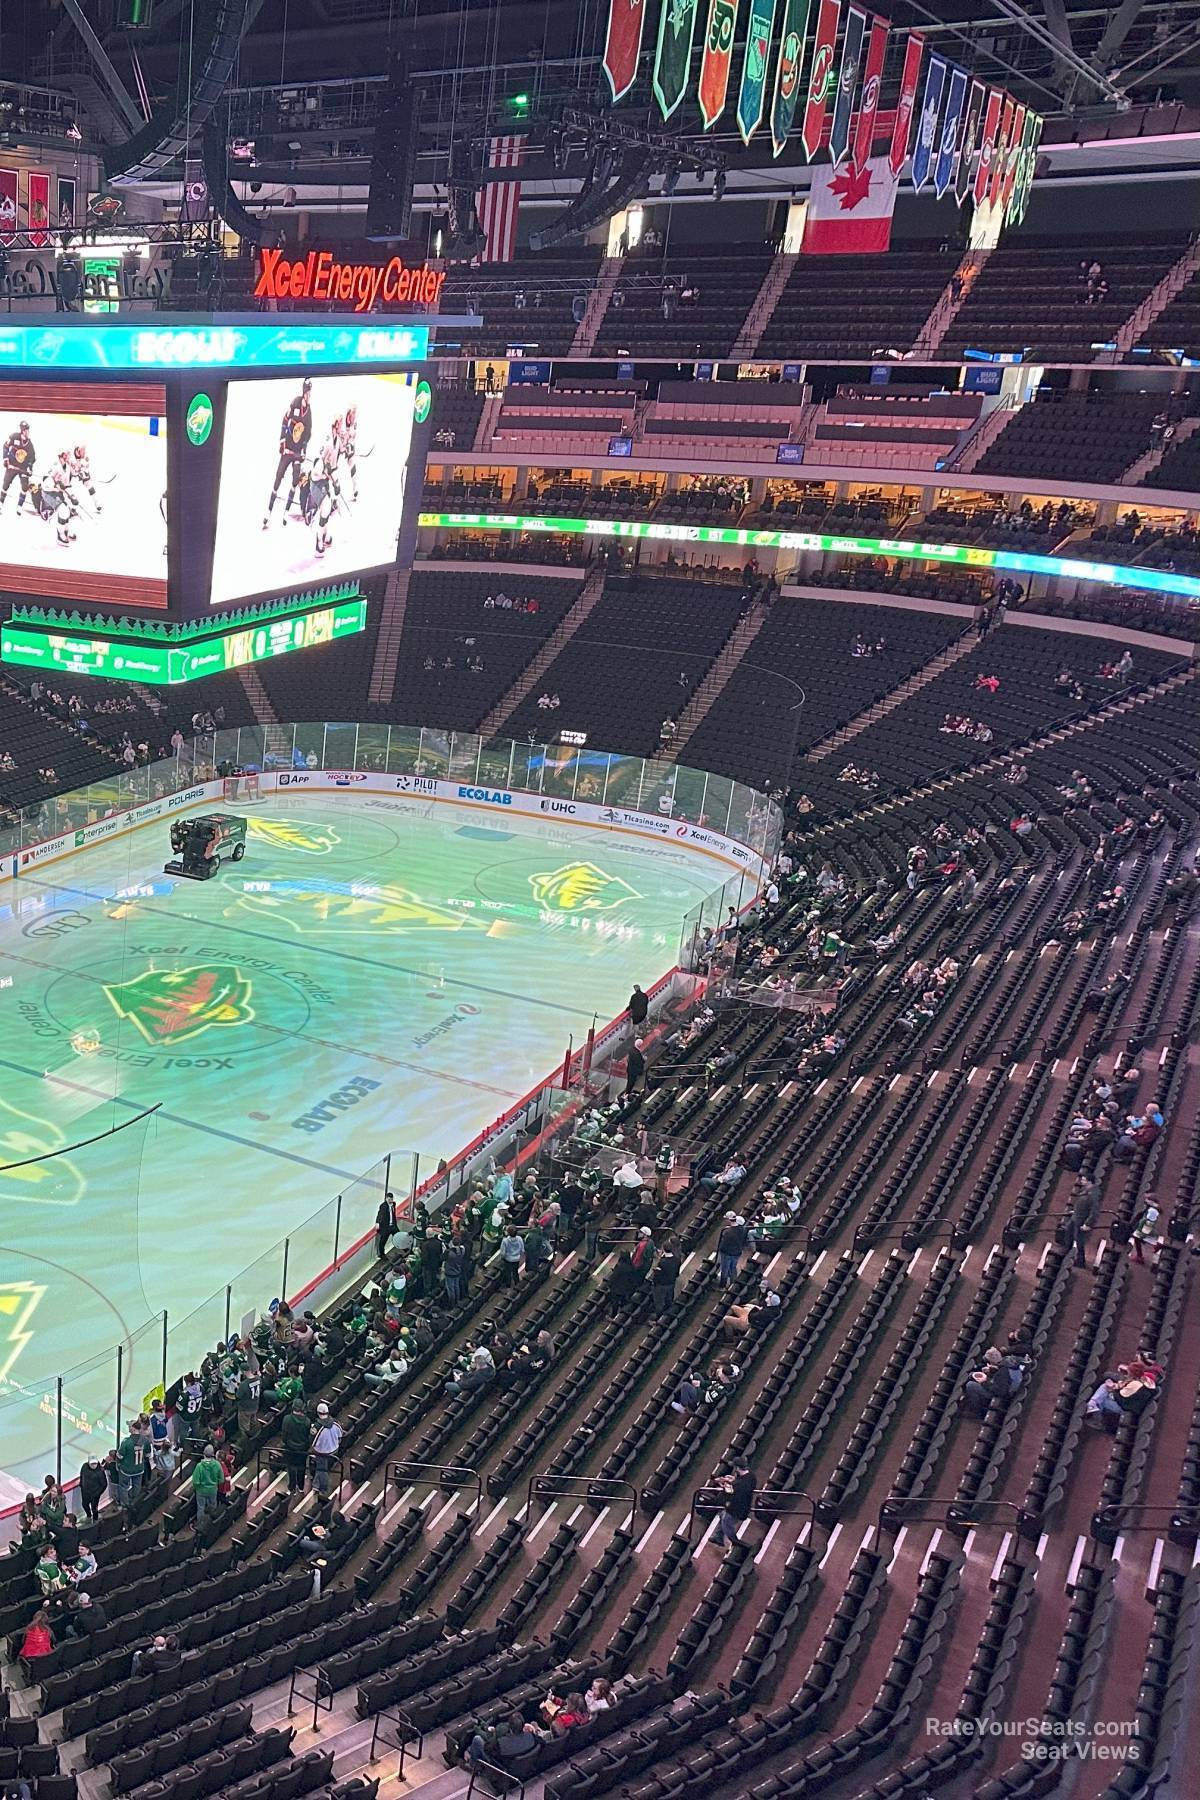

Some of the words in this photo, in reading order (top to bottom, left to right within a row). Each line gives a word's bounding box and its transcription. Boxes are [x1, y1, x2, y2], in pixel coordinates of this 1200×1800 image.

[255, 248, 316, 297] Xcel
[313, 252, 384, 311] Energy
[383, 256, 446, 302] Center
[414, 778, 438, 790] PILOT
[168, 788, 205, 807] POLARIS
[458, 786, 513, 805] ECOLAB
[551, 801, 577, 814] UHC
[36, 840, 65, 857] ANDERSEN
[690, 830, 707, 842] Xcel
[707, 836, 727, 850] Energy
[127, 945, 188, 956] Xcel
[195, 946, 284, 971] Energy
[284, 970, 336, 1006] Center
[16, 999, 61, 1037] Center
[163, 1057, 235, 1070] Xcel
[291, 1075, 383, 1133] ECOLAB
